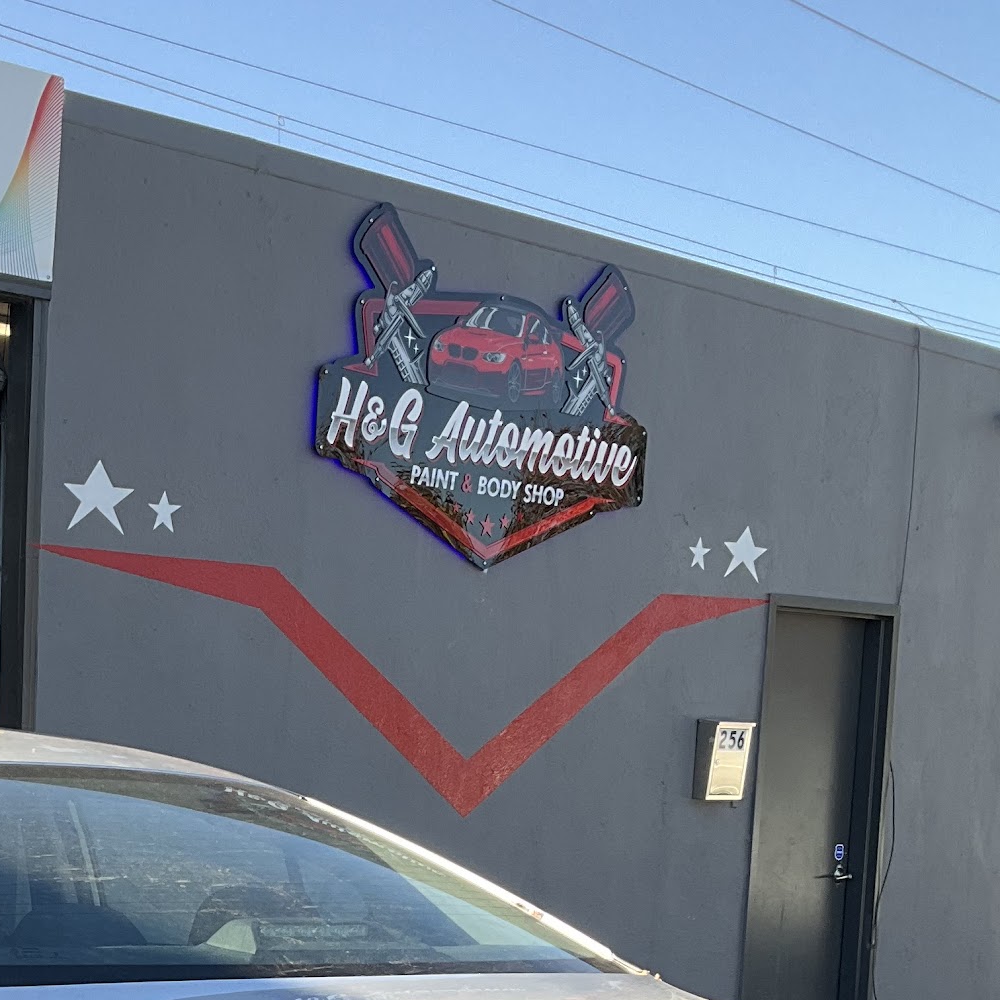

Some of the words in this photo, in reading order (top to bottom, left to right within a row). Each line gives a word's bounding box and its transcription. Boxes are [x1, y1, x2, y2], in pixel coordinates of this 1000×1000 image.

[327, 377, 424, 460] H&G
[425, 400, 638, 487] Automotive
[410, 464, 460, 491] PAINT
[462, 472, 473, 493] &
[477, 476, 522, 501] BODY
[523, 483, 564, 507] SHOP
[719, 730, 745, 750] 256
